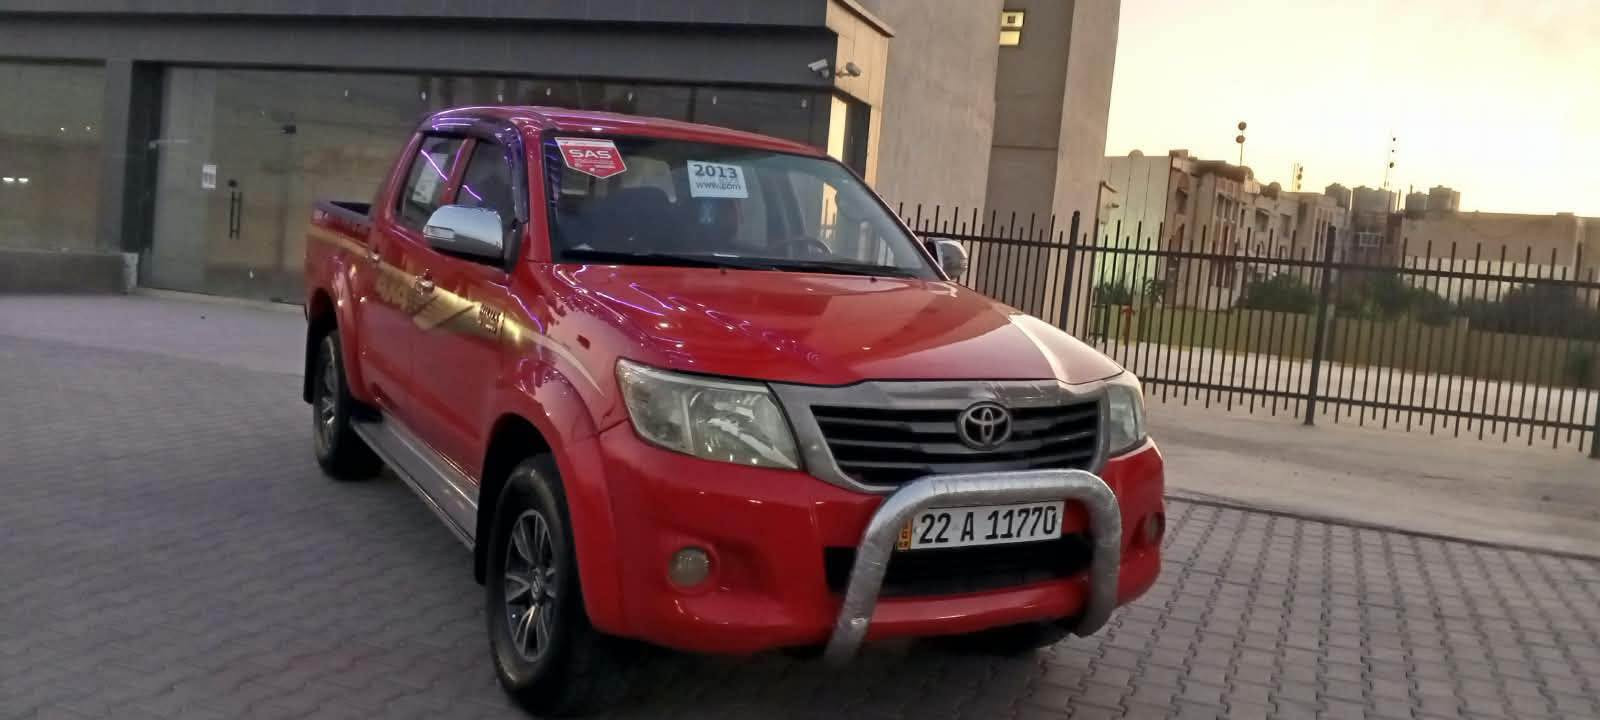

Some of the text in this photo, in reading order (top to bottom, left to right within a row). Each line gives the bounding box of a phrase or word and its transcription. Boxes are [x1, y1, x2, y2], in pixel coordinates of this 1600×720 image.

[569, 149, 612, 159] SAS
[693, 164, 738, 178] 2013
[919, 513, 951, 544] 22
[960, 511, 975, 542] A
[985, 506, 1057, 540] 11770
